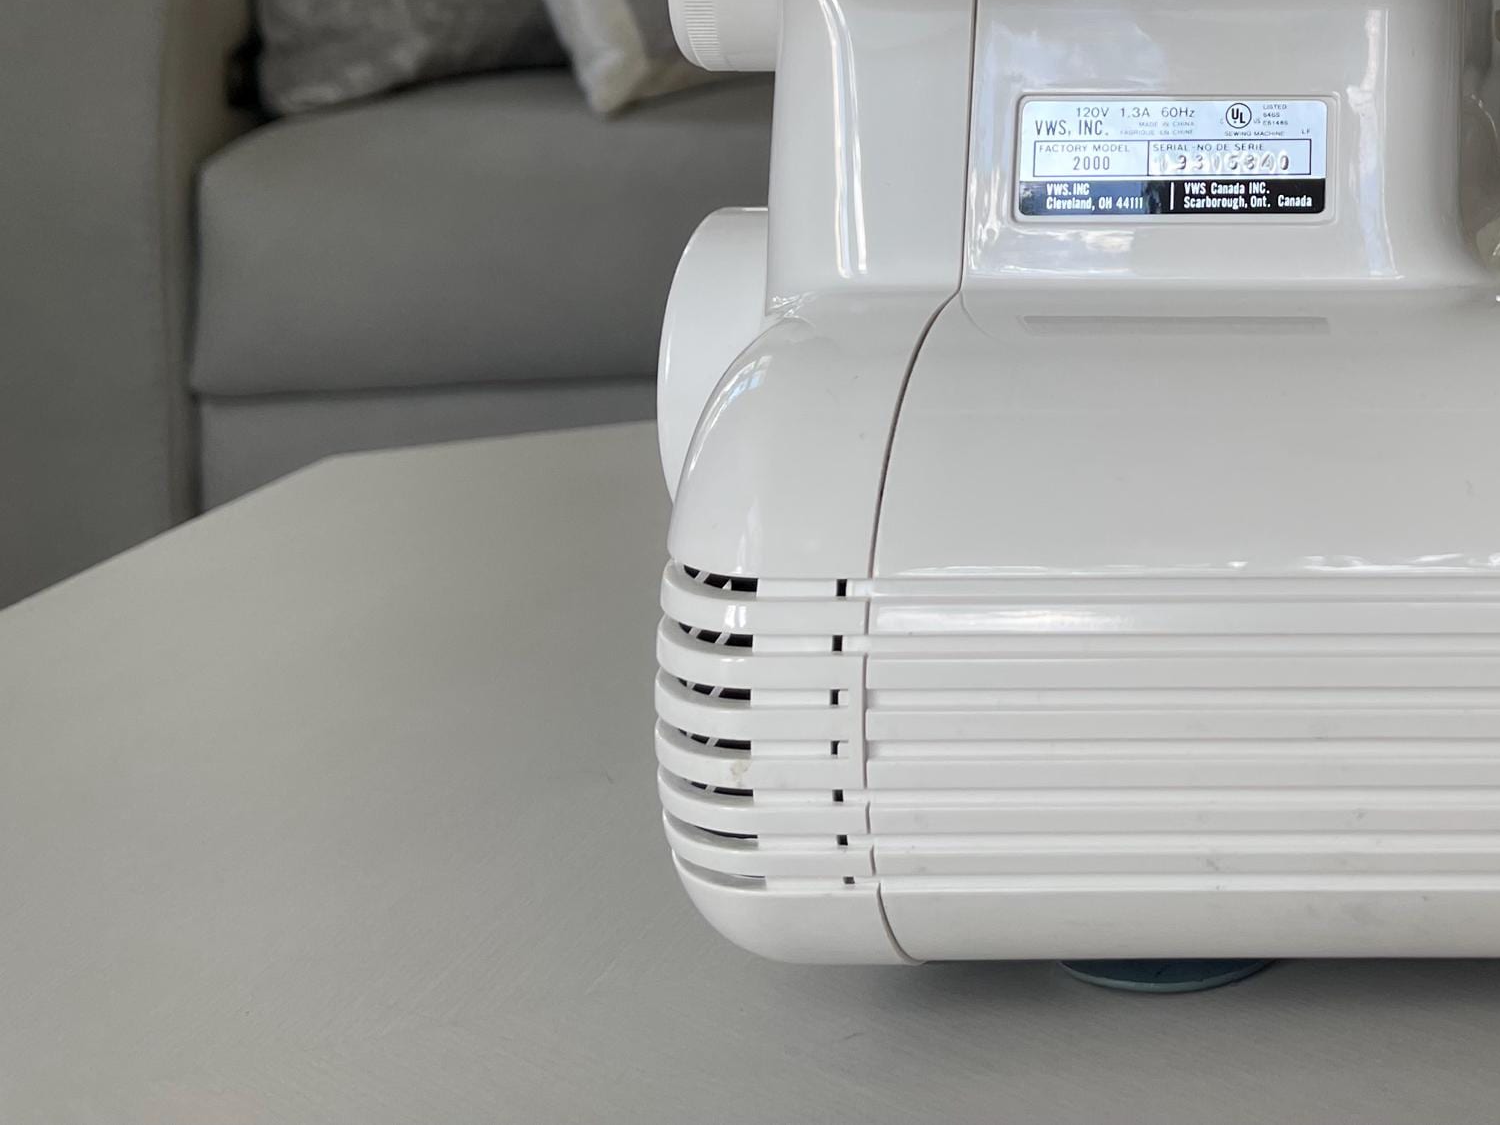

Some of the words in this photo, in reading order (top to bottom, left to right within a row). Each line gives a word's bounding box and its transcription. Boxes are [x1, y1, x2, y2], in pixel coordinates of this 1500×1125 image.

[1076, 107, 1110, 118] 120V
[1120, 107, 1151, 118] 1.3A
[1161, 107, 1195, 118] 60Hz
[1231, 107, 1246, 124] UL
[1078, 119, 1109, 136] INC.
[1039, 144, 1087, 153] FACTORY
[1092, 144, 1130, 153] MODEL
[1153, 143, 1188, 152] SERIAL
[1073, 156, 1110, 171] 2000
[1184, 182, 1206, 195] VWS
[1211, 182, 1245, 195] Canada
[1249, 182, 1270, 194] INC.
[1046, 197, 1095, 211] Cleveland,
[1099, 197, 1112, 209] OH
[1116, 197, 1143, 209] 44111
[1184, 196, 1248, 210] Scarborough,
[1251, 195, 1271, 208] Ont.
[1278, 194, 1313, 207] Canada
